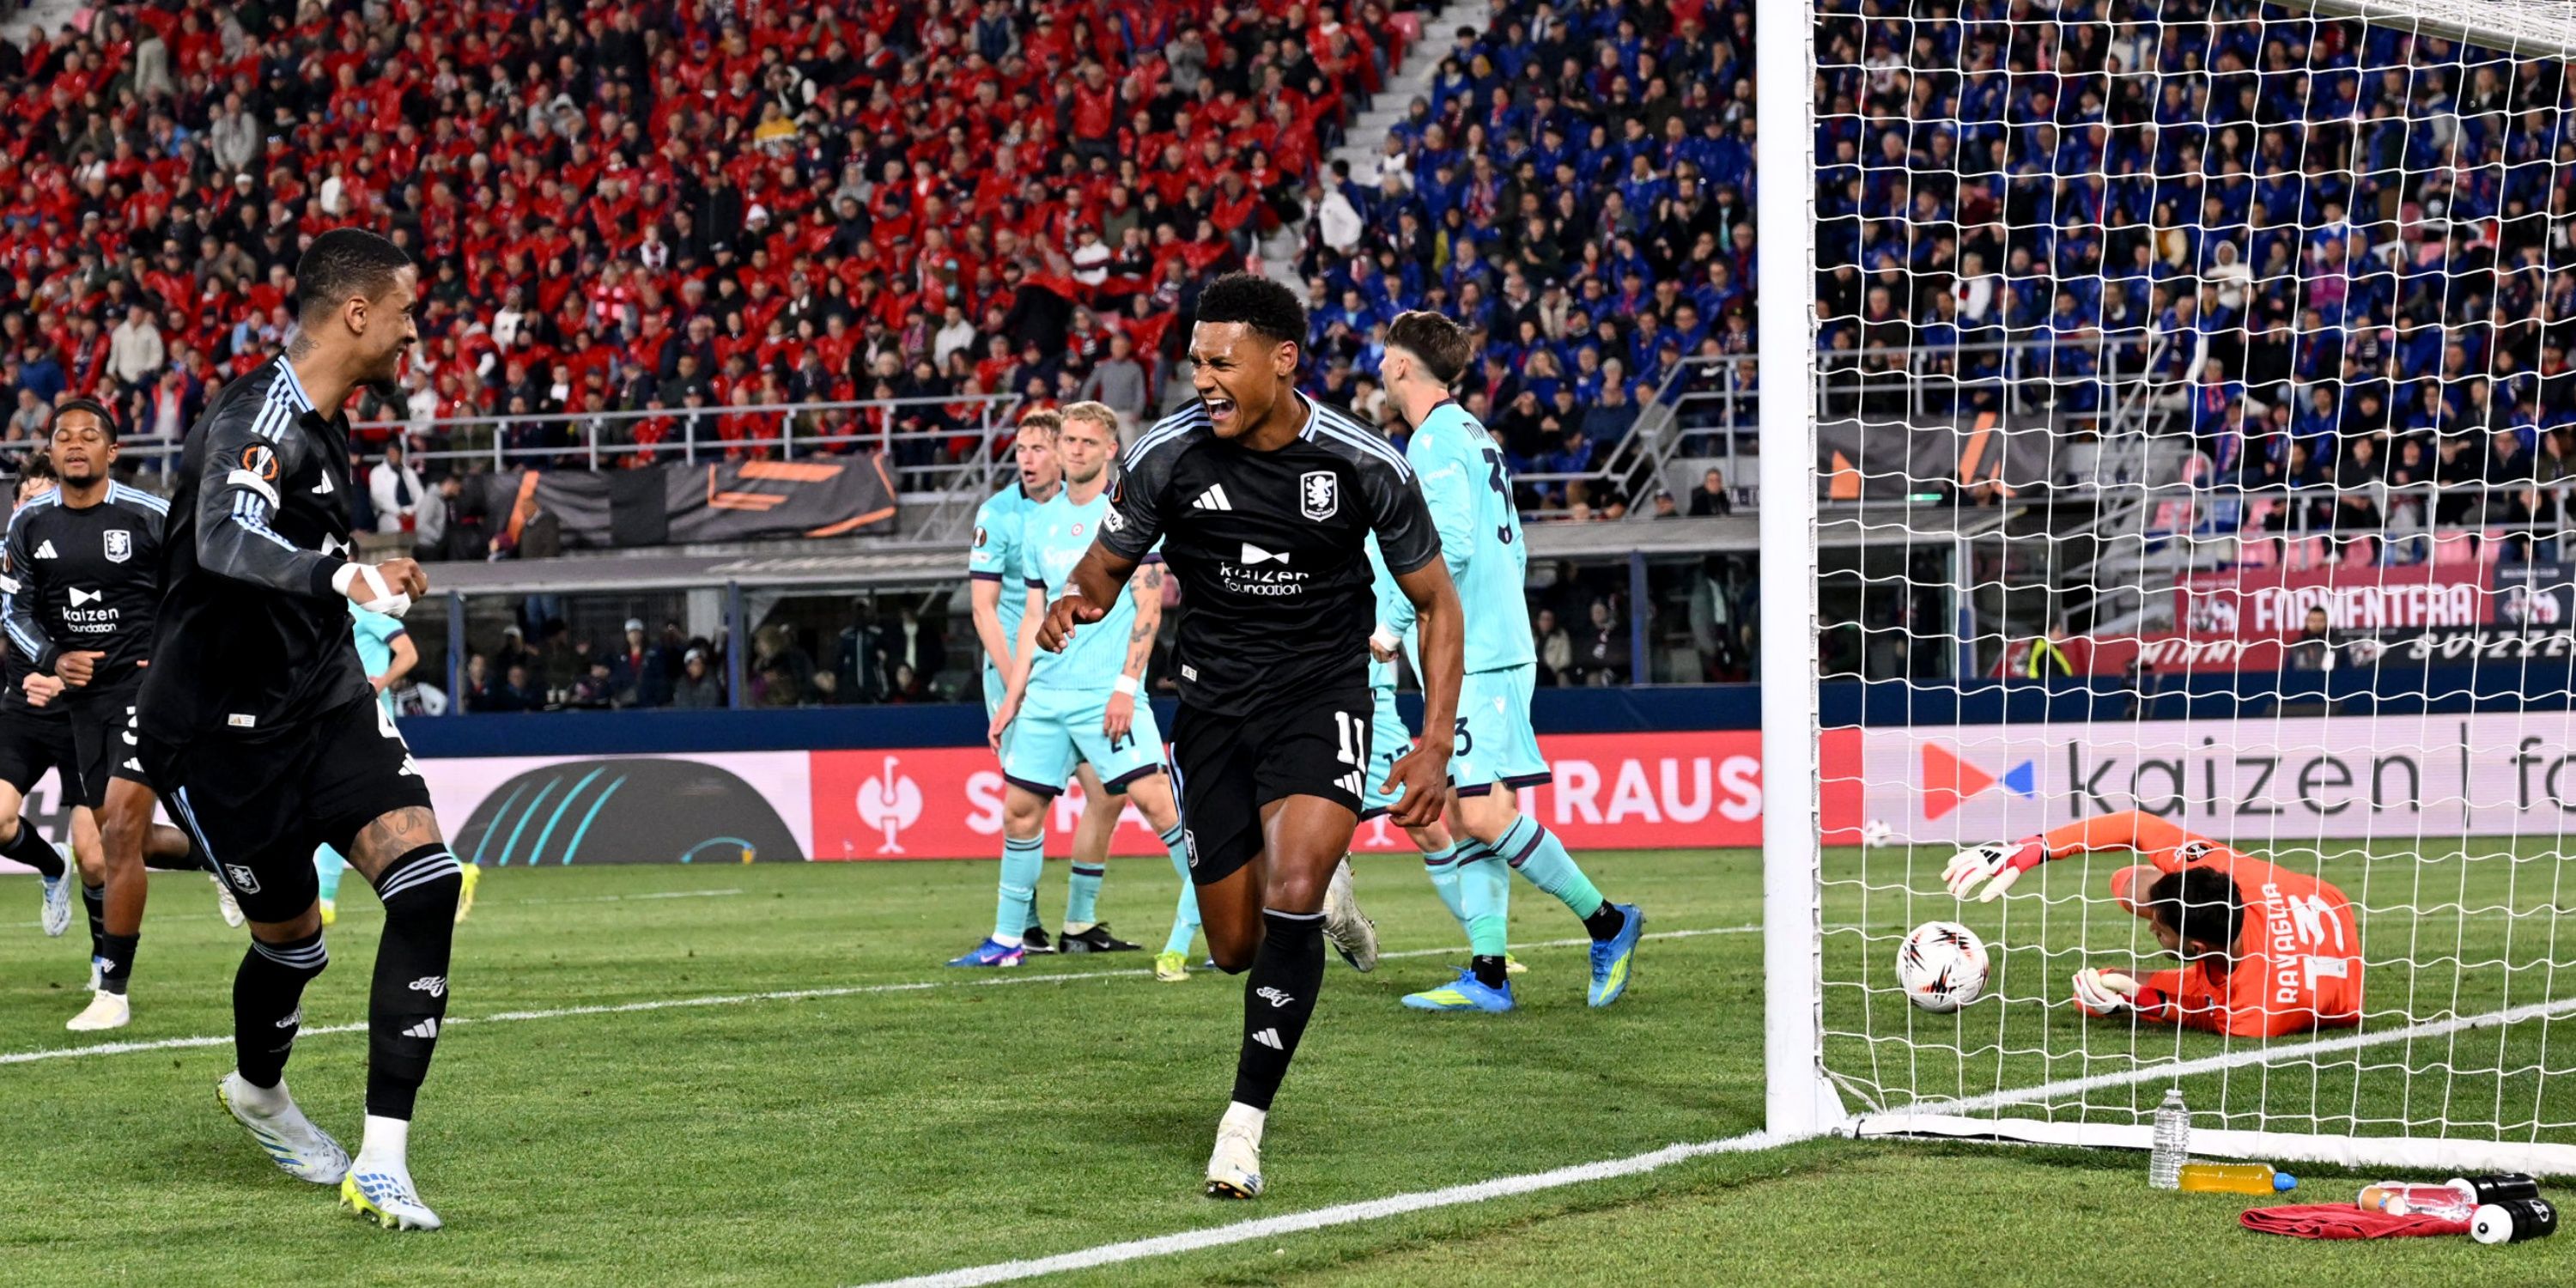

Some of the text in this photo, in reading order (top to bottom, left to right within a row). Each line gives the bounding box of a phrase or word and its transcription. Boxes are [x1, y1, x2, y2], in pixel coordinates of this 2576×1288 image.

[62, 605, 119, 622] kaizen
[2255, 582, 2474, 632] FORMENTERA
[1334, 710, 1367, 775] 11
[2068, 735, 2422, 818] kaizen
[2261, 882, 2299, 1004] RAVAGLIA
[2287, 894, 2348, 991] 13
